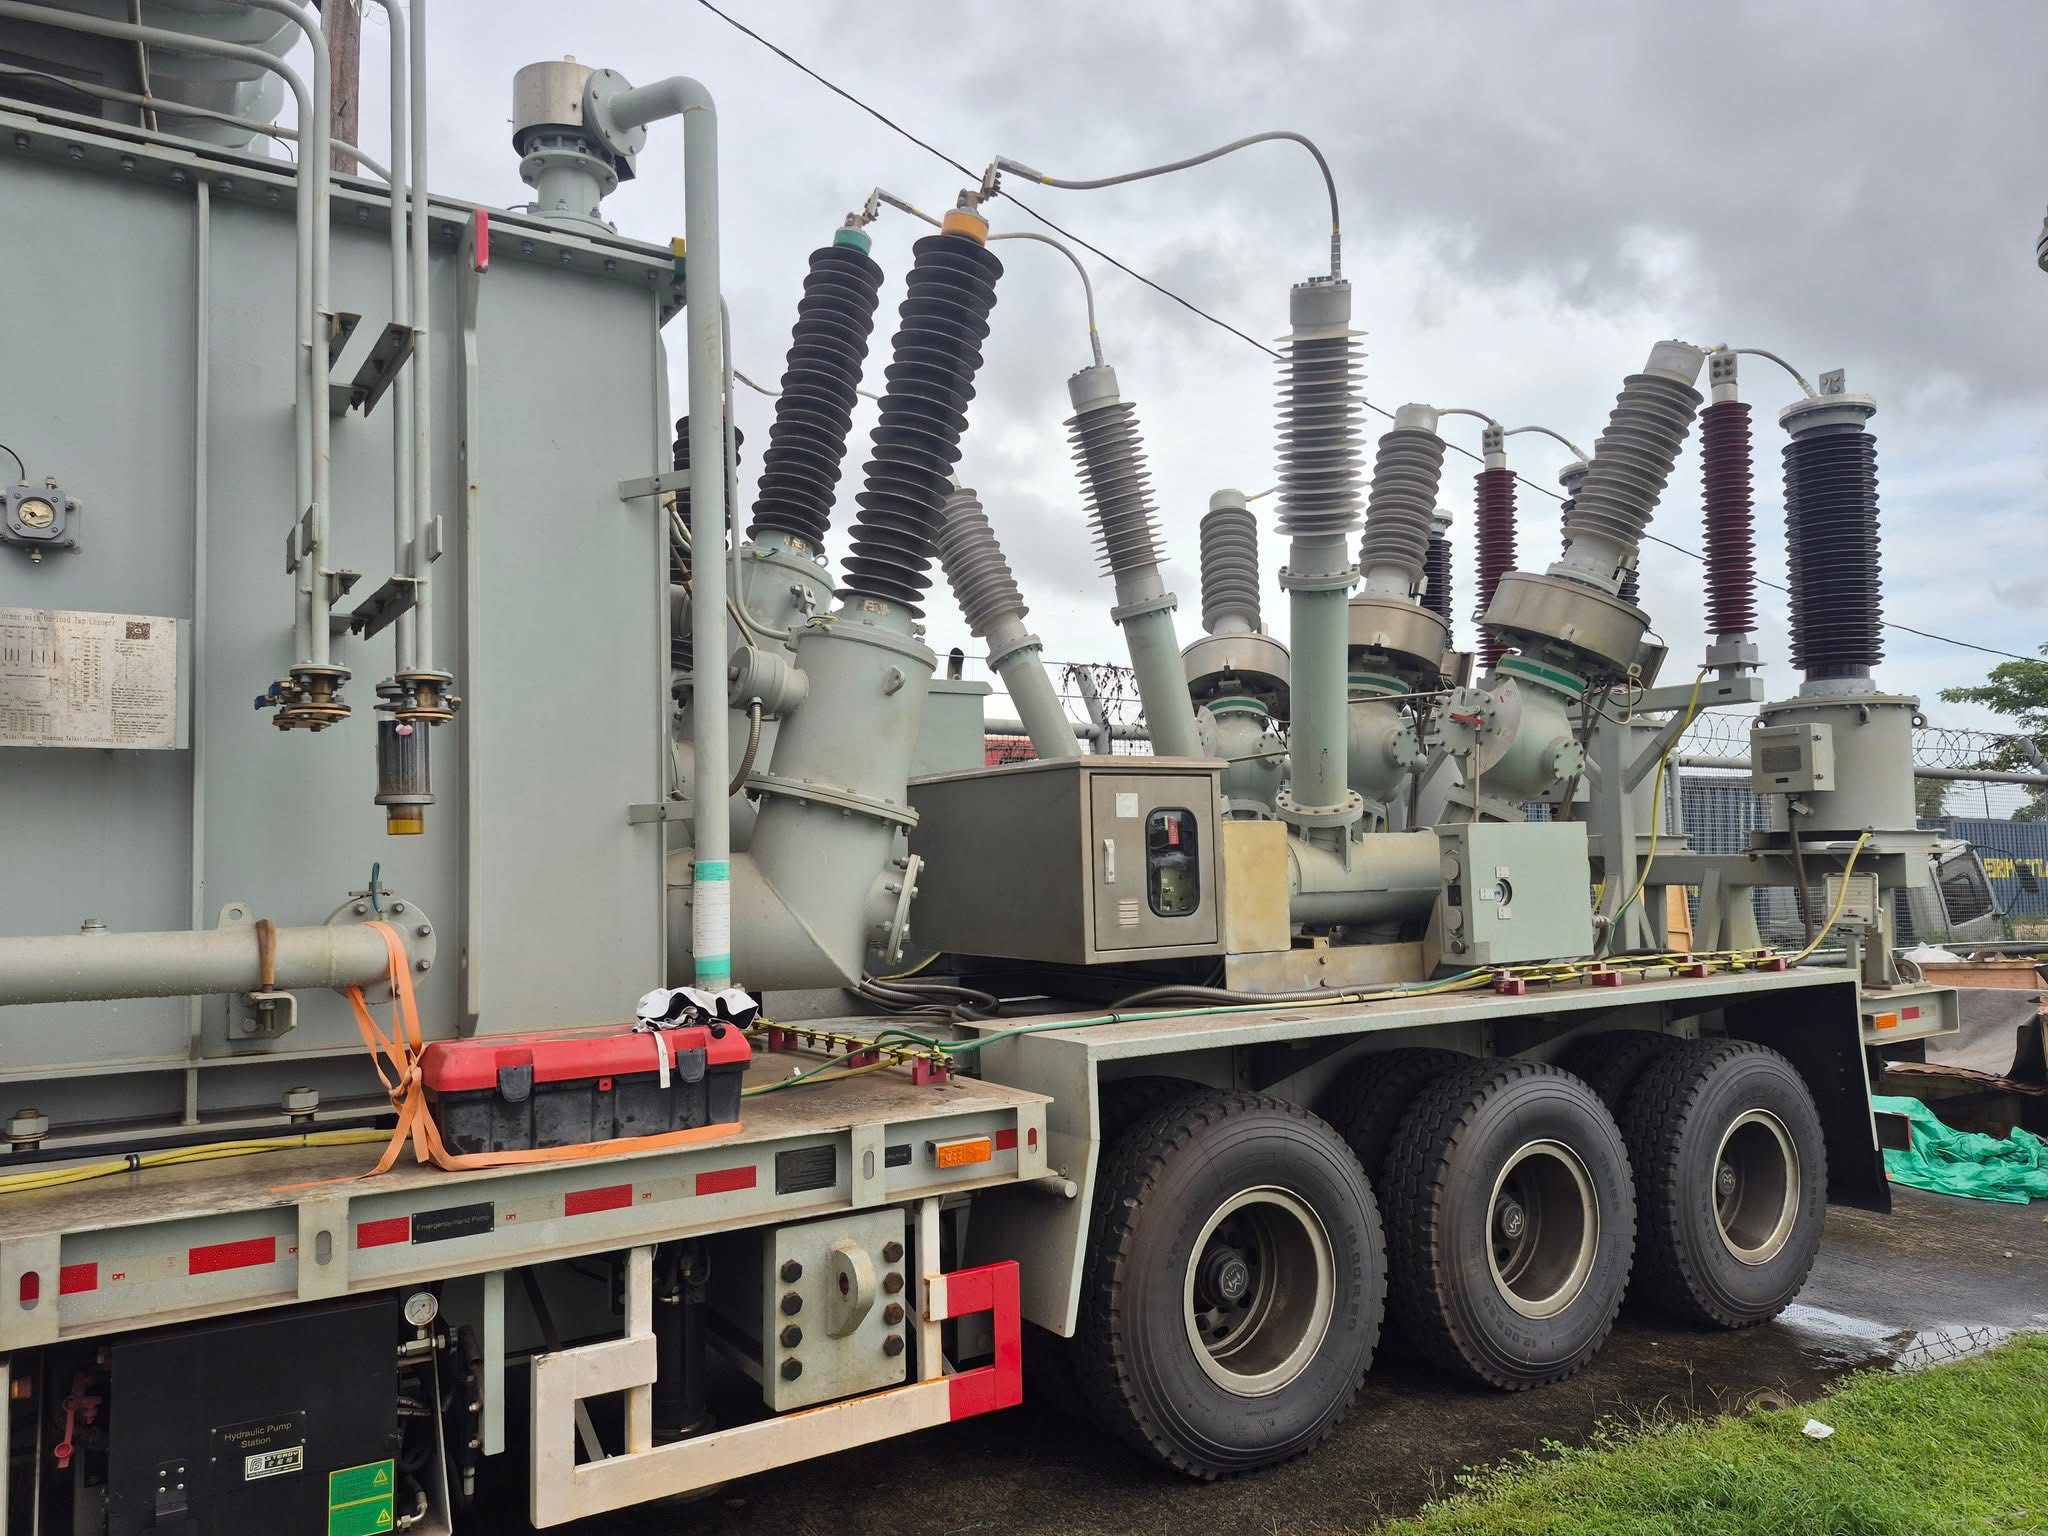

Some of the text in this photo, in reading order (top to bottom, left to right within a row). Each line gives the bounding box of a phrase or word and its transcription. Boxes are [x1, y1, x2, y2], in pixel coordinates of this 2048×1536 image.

[224, 1422, 292, 1442] Hydraulic Pump
[241, 1436, 271, 1448] Station
